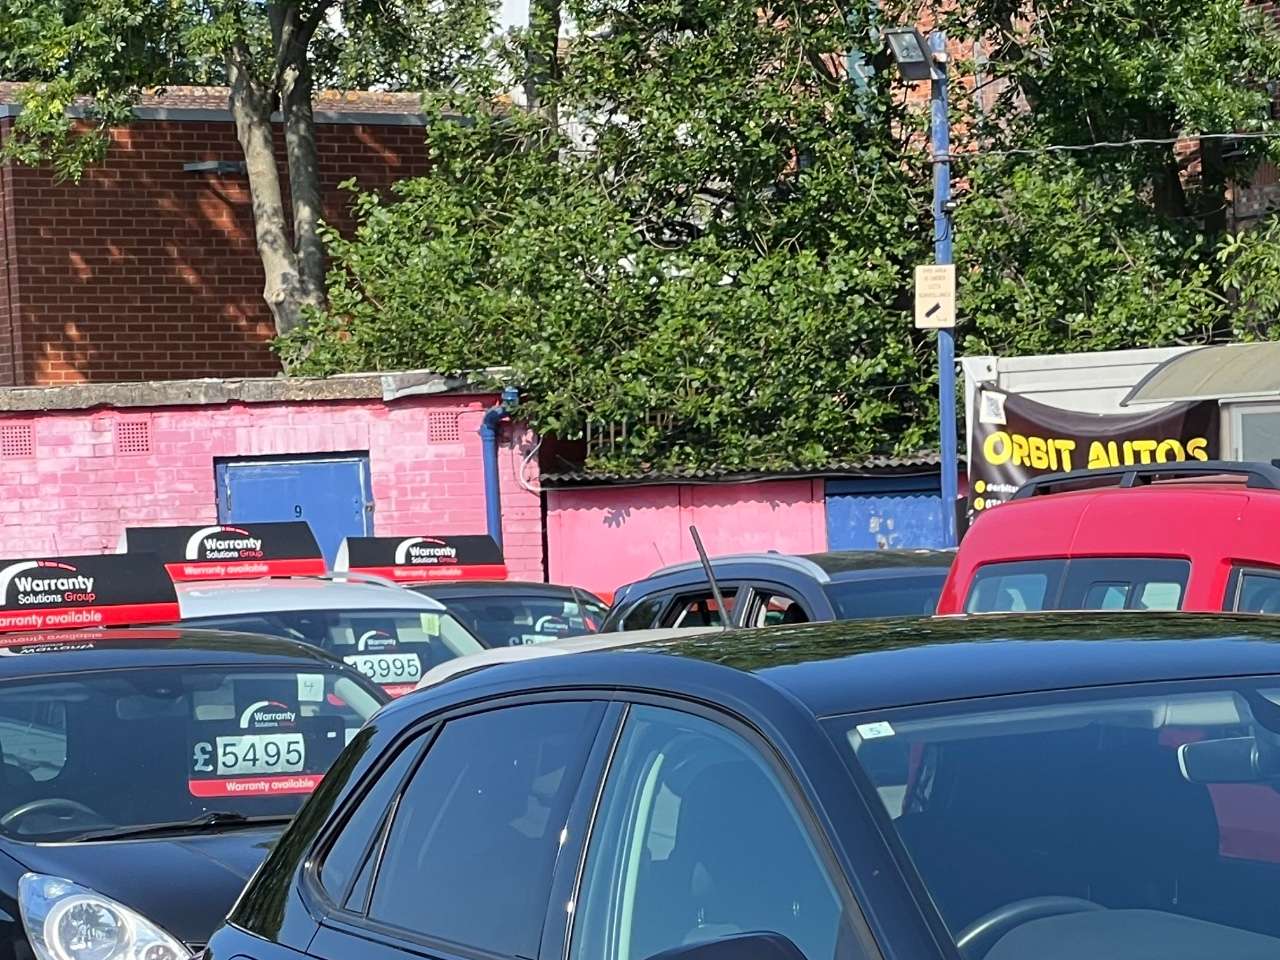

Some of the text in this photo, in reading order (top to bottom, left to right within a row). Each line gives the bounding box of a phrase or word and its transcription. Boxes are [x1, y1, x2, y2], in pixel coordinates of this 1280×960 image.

[983, 431, 1209, 473] ORBIT AUTOS
[294, 504, 302, 518] 9
[203, 537, 262, 551] Warranty
[206, 549, 264, 559] Solutions Group
[409, 547, 457, 558] Warranty
[184, 563, 269, 576] Warranty available
[14, 575, 95, 593] Warranty
[18, 591, 96, 605] Solutions Group
[0, 610, 103, 627] arranty available
[351, 658, 419, 678] 3995
[253, 711, 296, 722] Warranty
[226, 779, 315, 793] Warranty available
